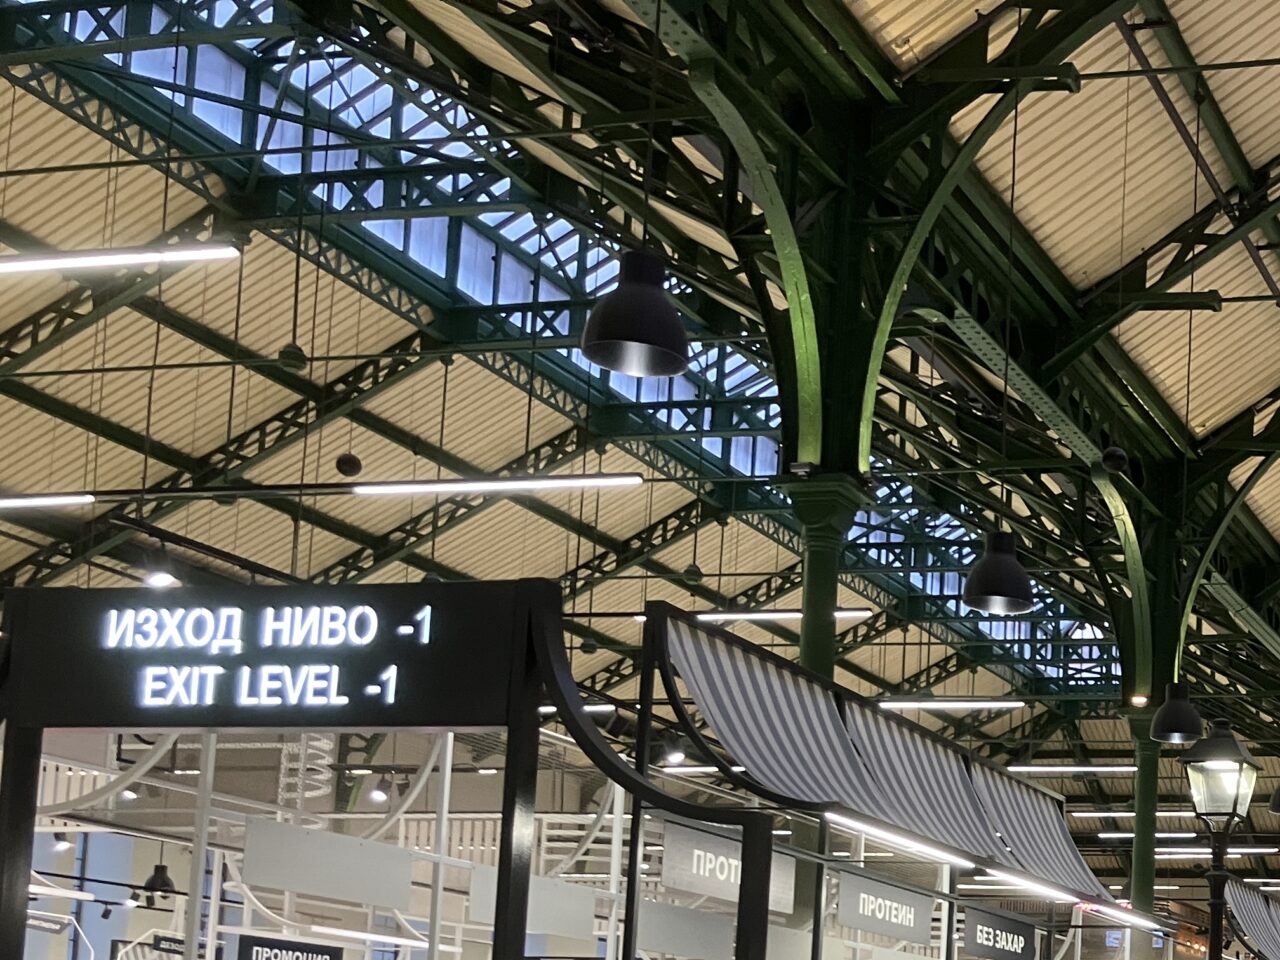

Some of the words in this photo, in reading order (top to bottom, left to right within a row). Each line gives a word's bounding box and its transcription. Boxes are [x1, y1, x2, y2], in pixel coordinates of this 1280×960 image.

[104, 607, 244, 655] ИЗХОД
[259, 605, 379, 647] НИВО
[396, 604, 433, 644] -1
[140, 665, 227, 706] EXIT
[235, 664, 350, 706] LEVEL
[364, 664, 399, 705] -1
[858, 893, 915, 928] ПРОТЕИН
[976, 924, 994, 946] БЕЗ
[994, 928, 1026, 954] ЗАХАР
